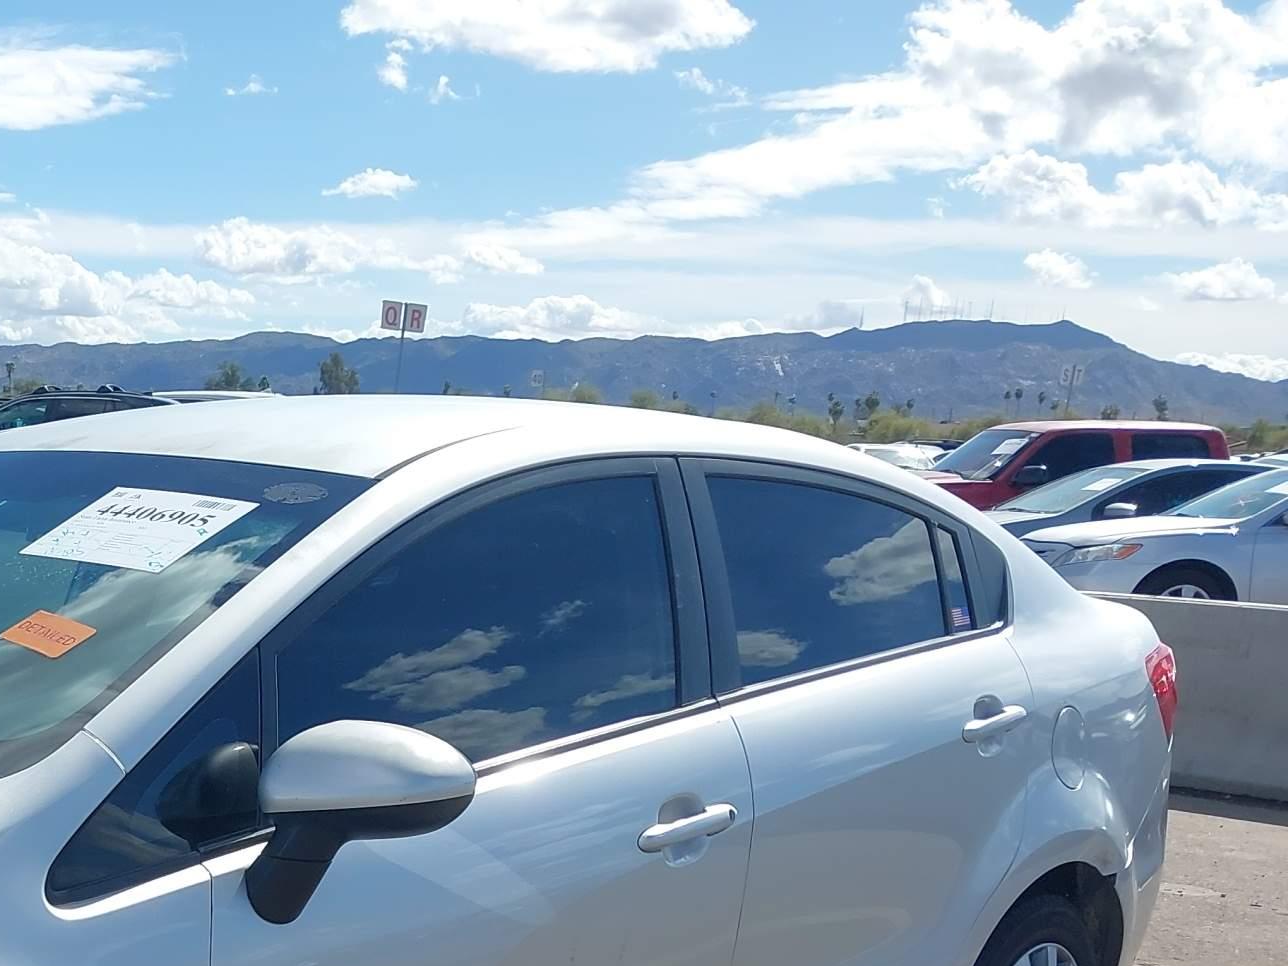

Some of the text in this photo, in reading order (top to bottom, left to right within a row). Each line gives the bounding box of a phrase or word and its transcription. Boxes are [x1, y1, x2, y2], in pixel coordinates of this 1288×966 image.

[385, 306, 422, 329] Q R
[97, 503, 217, 528] 44406905
[18, 620, 76, 646] DETAILED
